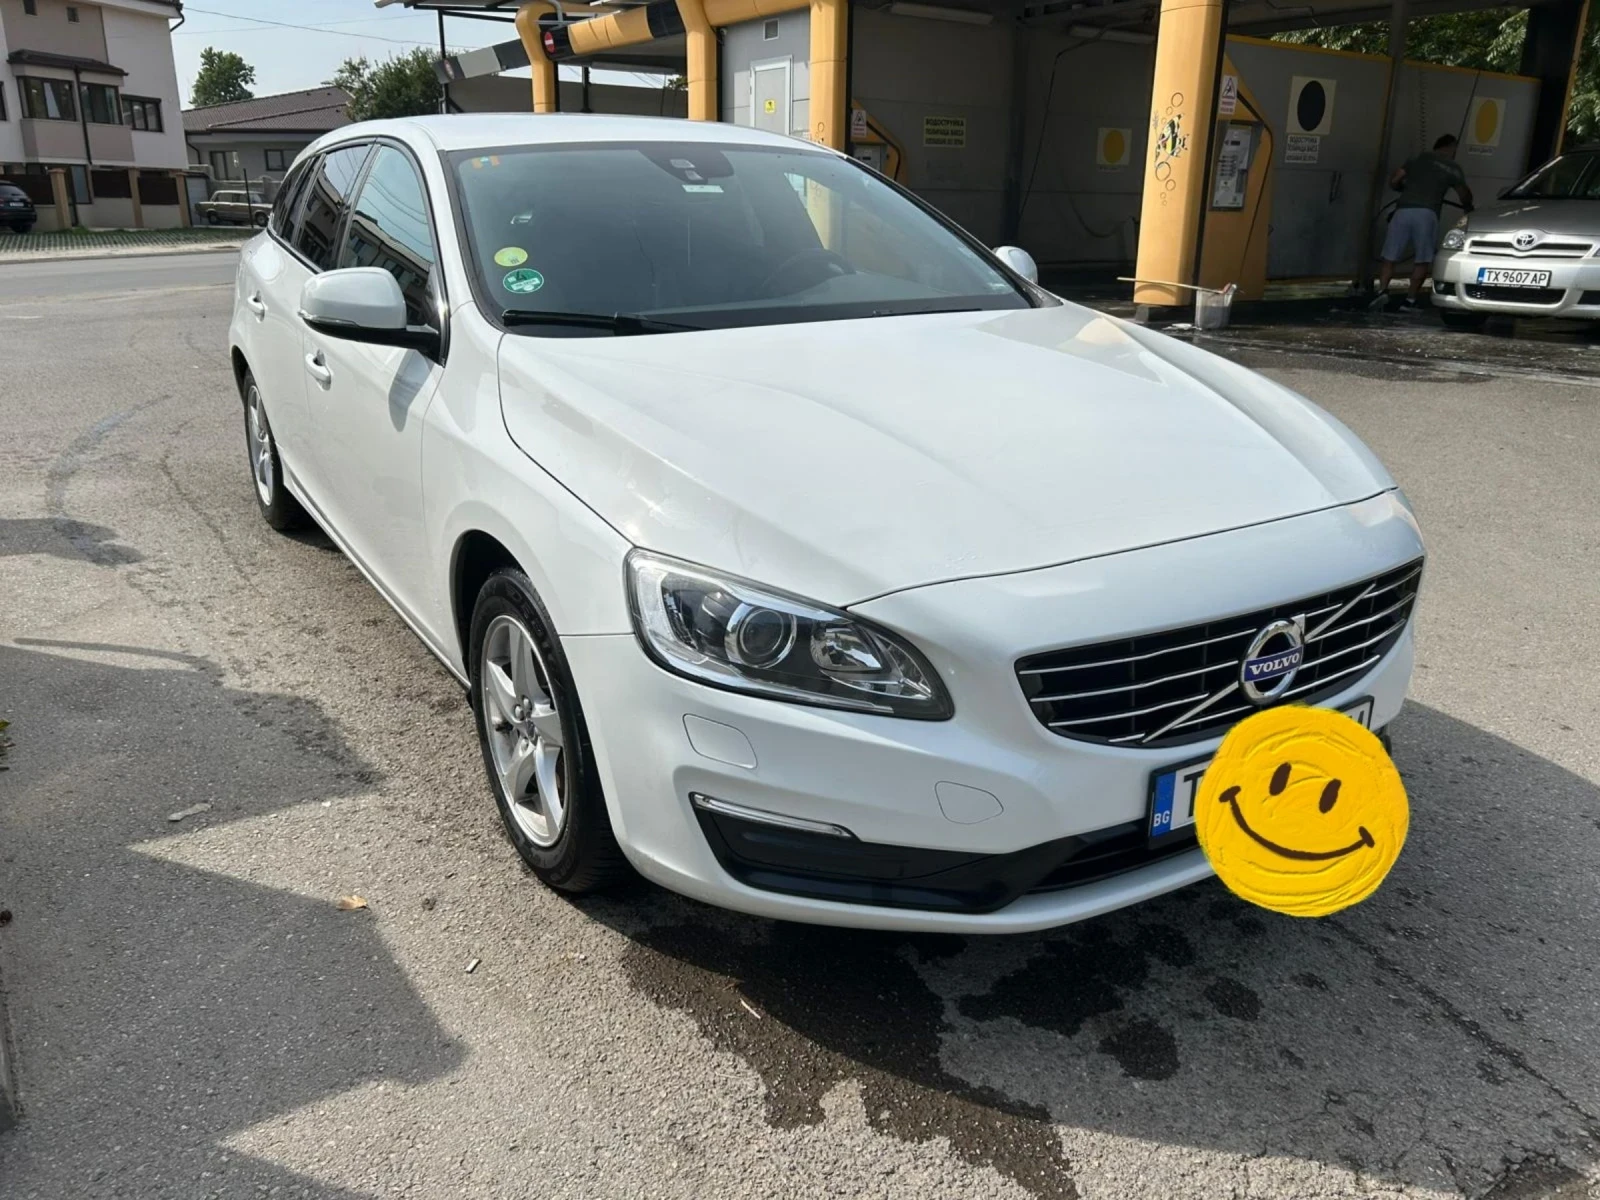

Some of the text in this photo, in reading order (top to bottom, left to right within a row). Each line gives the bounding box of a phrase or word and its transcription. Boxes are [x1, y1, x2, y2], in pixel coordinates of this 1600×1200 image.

[1487, 270, 1501, 282] TX
[1502, 271, 1530, 283] 9607
[1530, 273, 1547, 284] AP
[1249, 653, 1300, 675] VOLVO
[1153, 810, 1170, 827] BG
